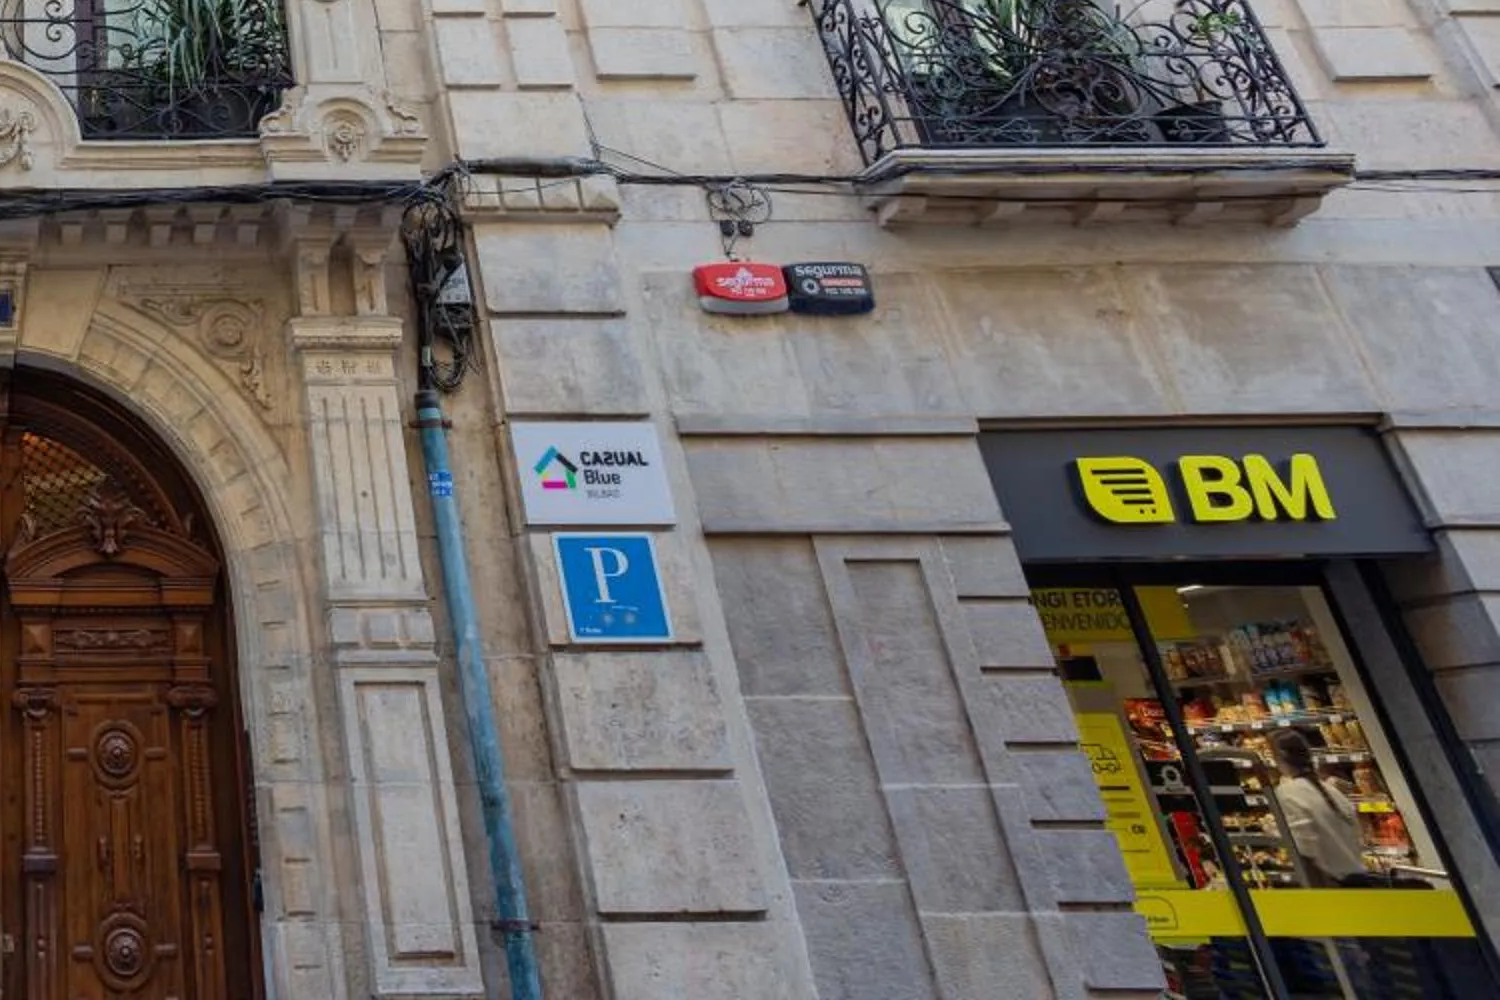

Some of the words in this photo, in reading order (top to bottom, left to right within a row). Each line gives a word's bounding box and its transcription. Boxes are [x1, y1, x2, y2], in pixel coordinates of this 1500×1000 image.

[583, 469, 621, 485] Blue
[1177, 453, 1336, 522] BM
[583, 547, 629, 603] P
